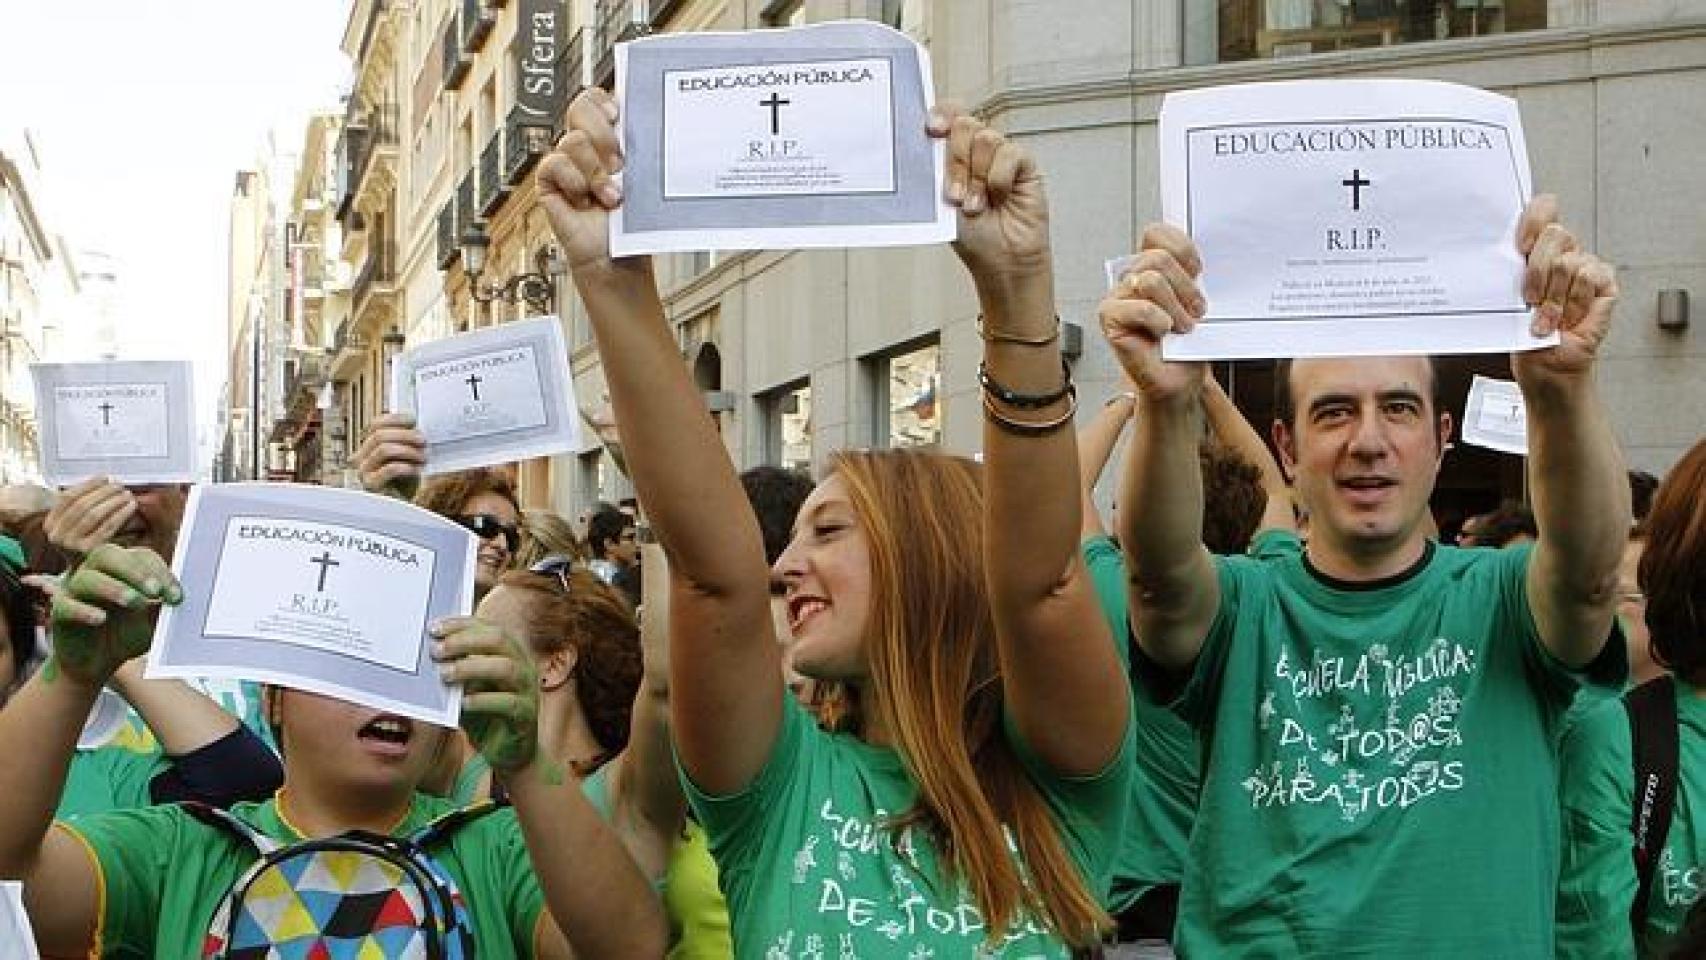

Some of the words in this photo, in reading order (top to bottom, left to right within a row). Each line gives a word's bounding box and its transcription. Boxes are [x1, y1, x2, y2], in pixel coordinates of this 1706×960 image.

[521, 12, 555, 96] Sfera
[677, 71, 790, 91] EDUCACIÓN
[794, 68, 874, 86] PÚBLICA
[1215, 127, 1377, 156] EDUCACIÓN
[1385, 124, 1493, 149] PÚBLICA
[1325, 227, 1387, 251] R.I.P.
[238, 524, 345, 547] EDUCACIÓN
[346, 536, 420, 567] PÚBLICA
[818, 878, 878, 926] DE
